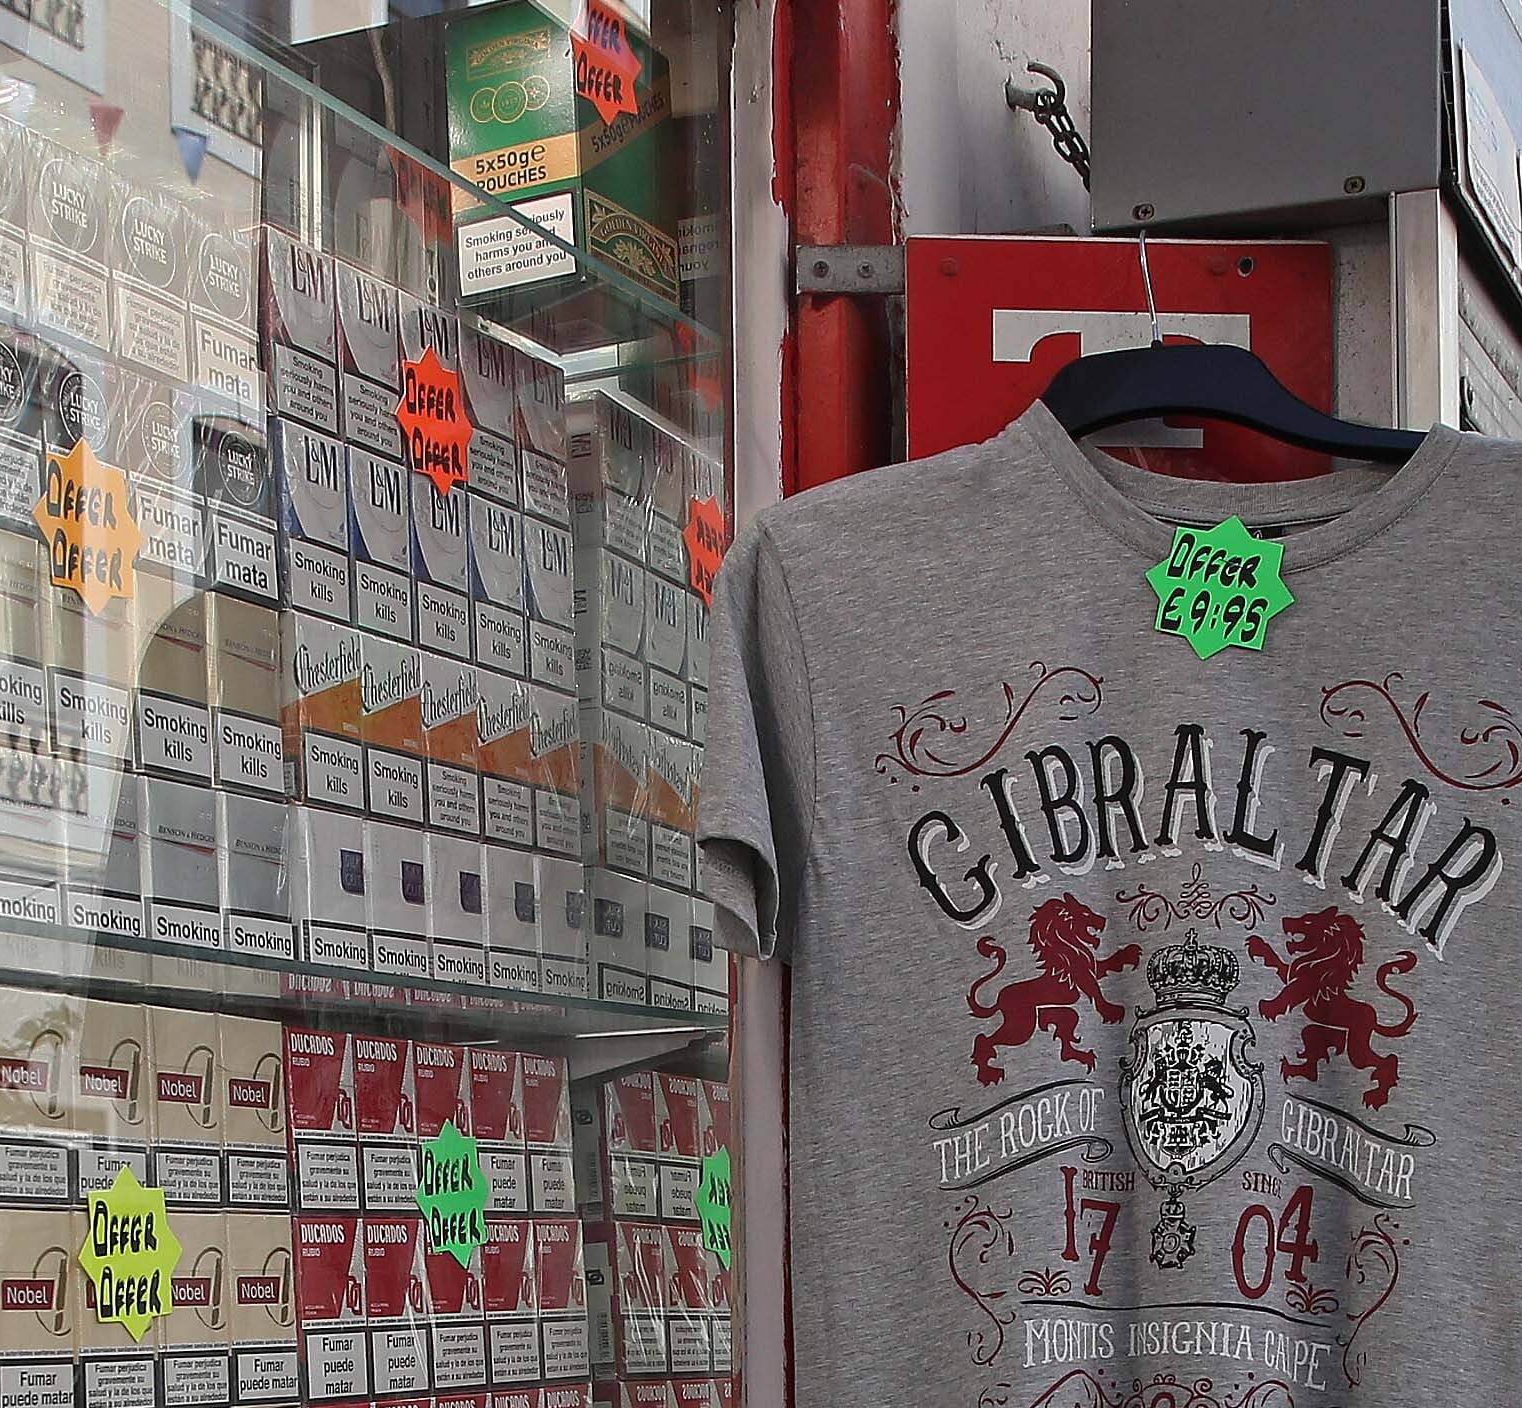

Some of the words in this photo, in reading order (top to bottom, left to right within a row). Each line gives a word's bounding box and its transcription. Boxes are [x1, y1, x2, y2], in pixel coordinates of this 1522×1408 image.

[578, 52, 623, 104] OFFER
[133, 233, 168, 266] STRIKE
[134, 218, 165, 247] LUCKY
[465, 229, 512, 249] Smoking
[475, 244, 509, 262] harms
[511, 241, 532, 260] you
[467, 263, 503, 281] others
[504, 255, 543, 273] around
[546, 251, 567, 270] you
[408, 369, 456, 422] OFFER
[218, 519, 273, 564] Fumar
[1165, 532, 1263, 591] OFFER
[225, 551, 269, 592] mata
[295, 551, 346, 587] Smoking
[310, 582, 334, 603] kills
[294, 642, 360, 697] Chesterfield
[906, 723, 1503, 962] GIBRALTAR
[161, 1079, 198, 1099] Nobel
[932, 1125, 992, 1185] THE
[999, 1098, 1076, 1162] ROCK
[1077, 1087, 1106, 1132] OF
[1280, 1097, 1418, 1200] GIBRALTAR
[424, 1152, 472, 1200] OFFER
[1082, 1168, 1136, 1193] BRITISH
[1241, 1169, 1285, 1196] SINCE
[93, 1201, 157, 1258] OFFER
[99, 1266, 162, 1319] OFFER
[1022, 1317, 1116, 1369] MONTIS
[1127, 1318, 1254, 1362] INSIGNIA
